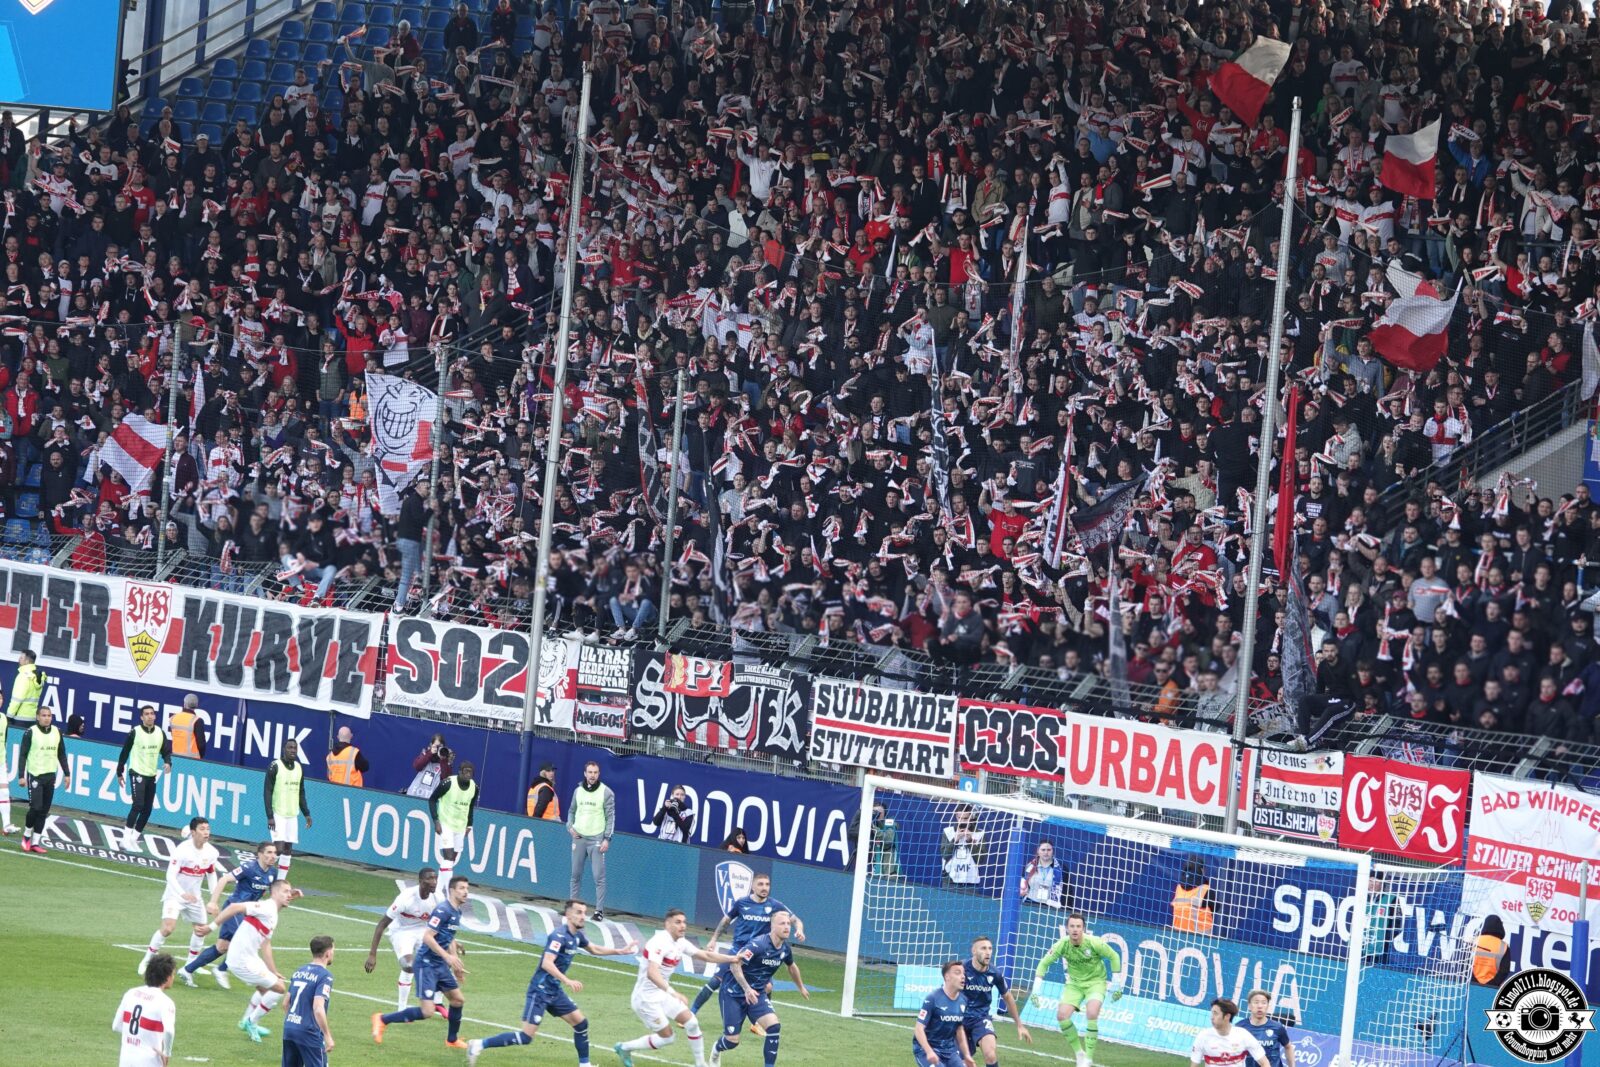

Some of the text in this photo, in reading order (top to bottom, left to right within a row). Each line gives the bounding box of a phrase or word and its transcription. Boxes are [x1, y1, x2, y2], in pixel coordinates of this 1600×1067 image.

[0, 567, 372, 706] TER KURVE
[579, 661, 629, 677] BEDEUTET
[581, 645, 630, 665] ULTRAS
[578, 673, 629, 688] WIDERSTAND
[816, 684, 956, 733] SÜDBANDE
[812, 729, 950, 775] STUTTGART
[964, 705, 1061, 774] C36S
[1264, 782, 1316, 804] Inferno
[1254, 810, 1316, 833] OSTELSHEIM
[1481, 790, 1600, 833] BAD WIMPFE
[40, 836, 160, 868] Generatoren
[1472, 842, 1600, 886] STAUFER SCHWABE
[1502, 900, 1523, 913] seit
[293, 980, 308, 1013] 7
[129, 1004, 143, 1036] 8
